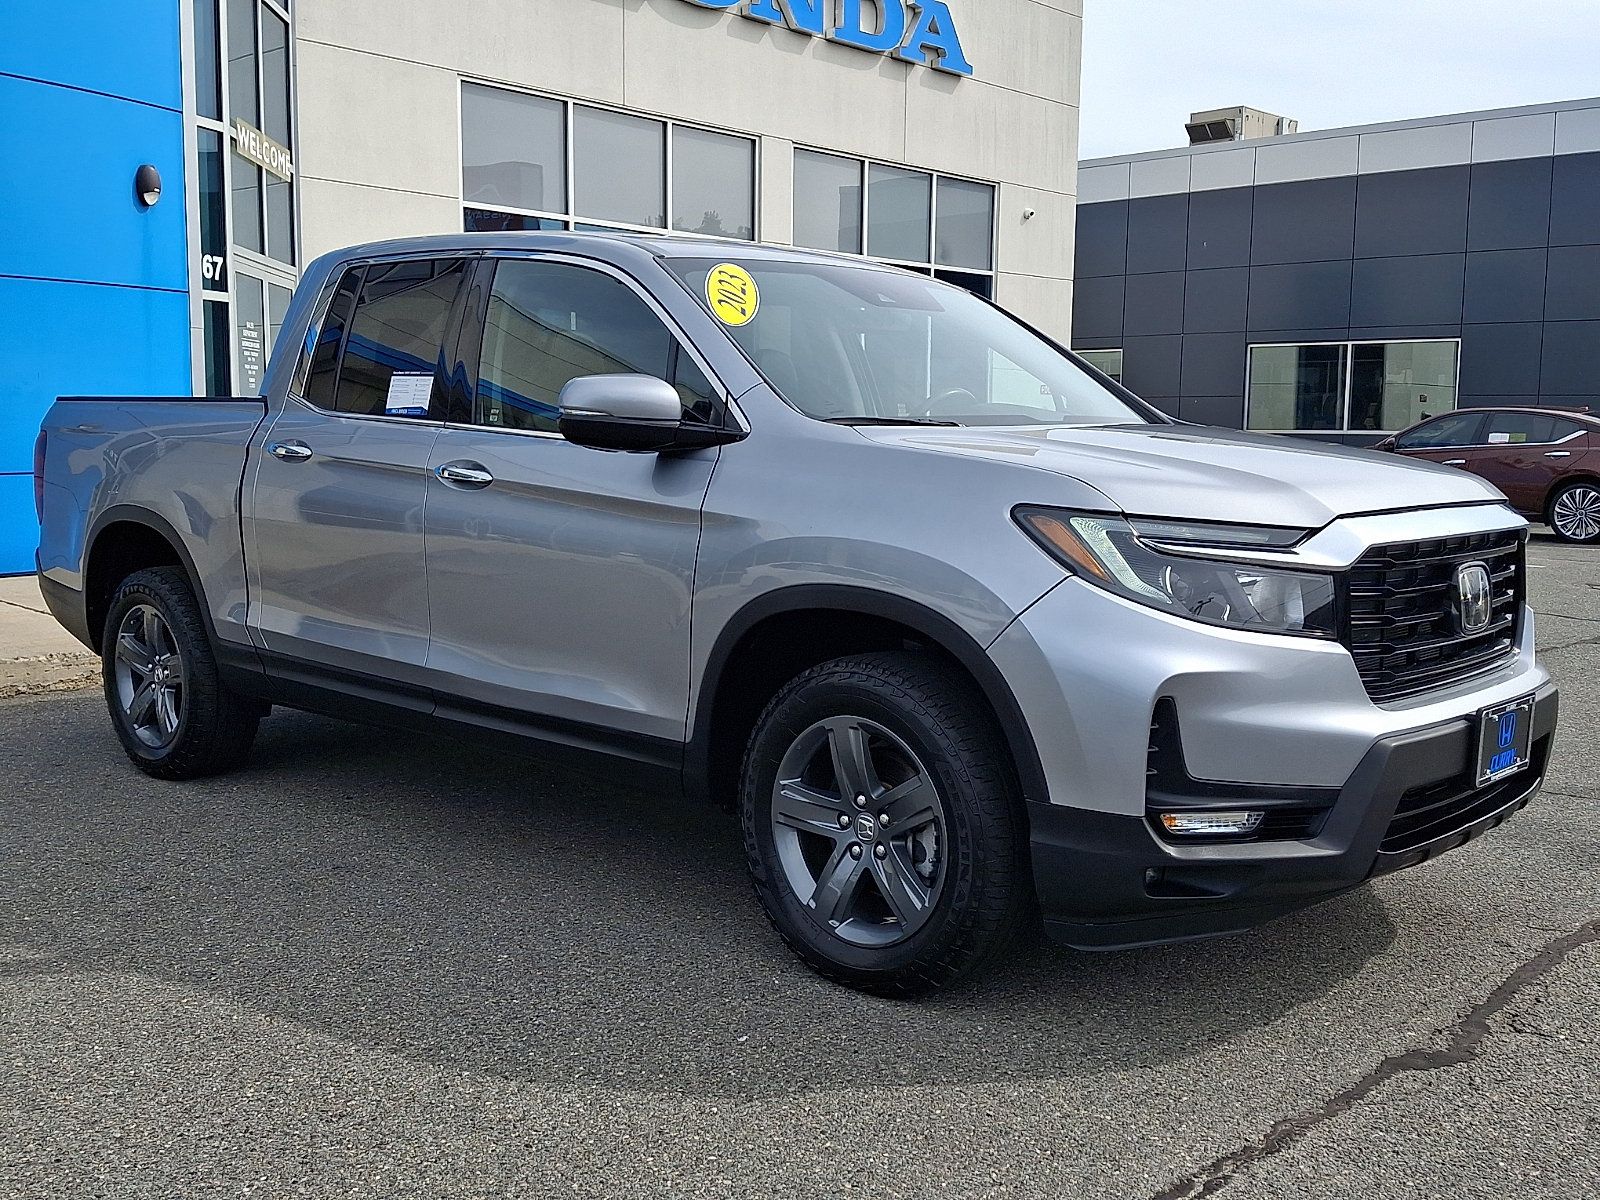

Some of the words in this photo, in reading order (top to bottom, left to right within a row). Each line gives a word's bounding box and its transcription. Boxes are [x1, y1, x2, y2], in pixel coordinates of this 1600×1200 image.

[237, 124, 291, 178] WELCOME
[203, 254, 224, 281] 67
[717, 270, 747, 317] 2023
